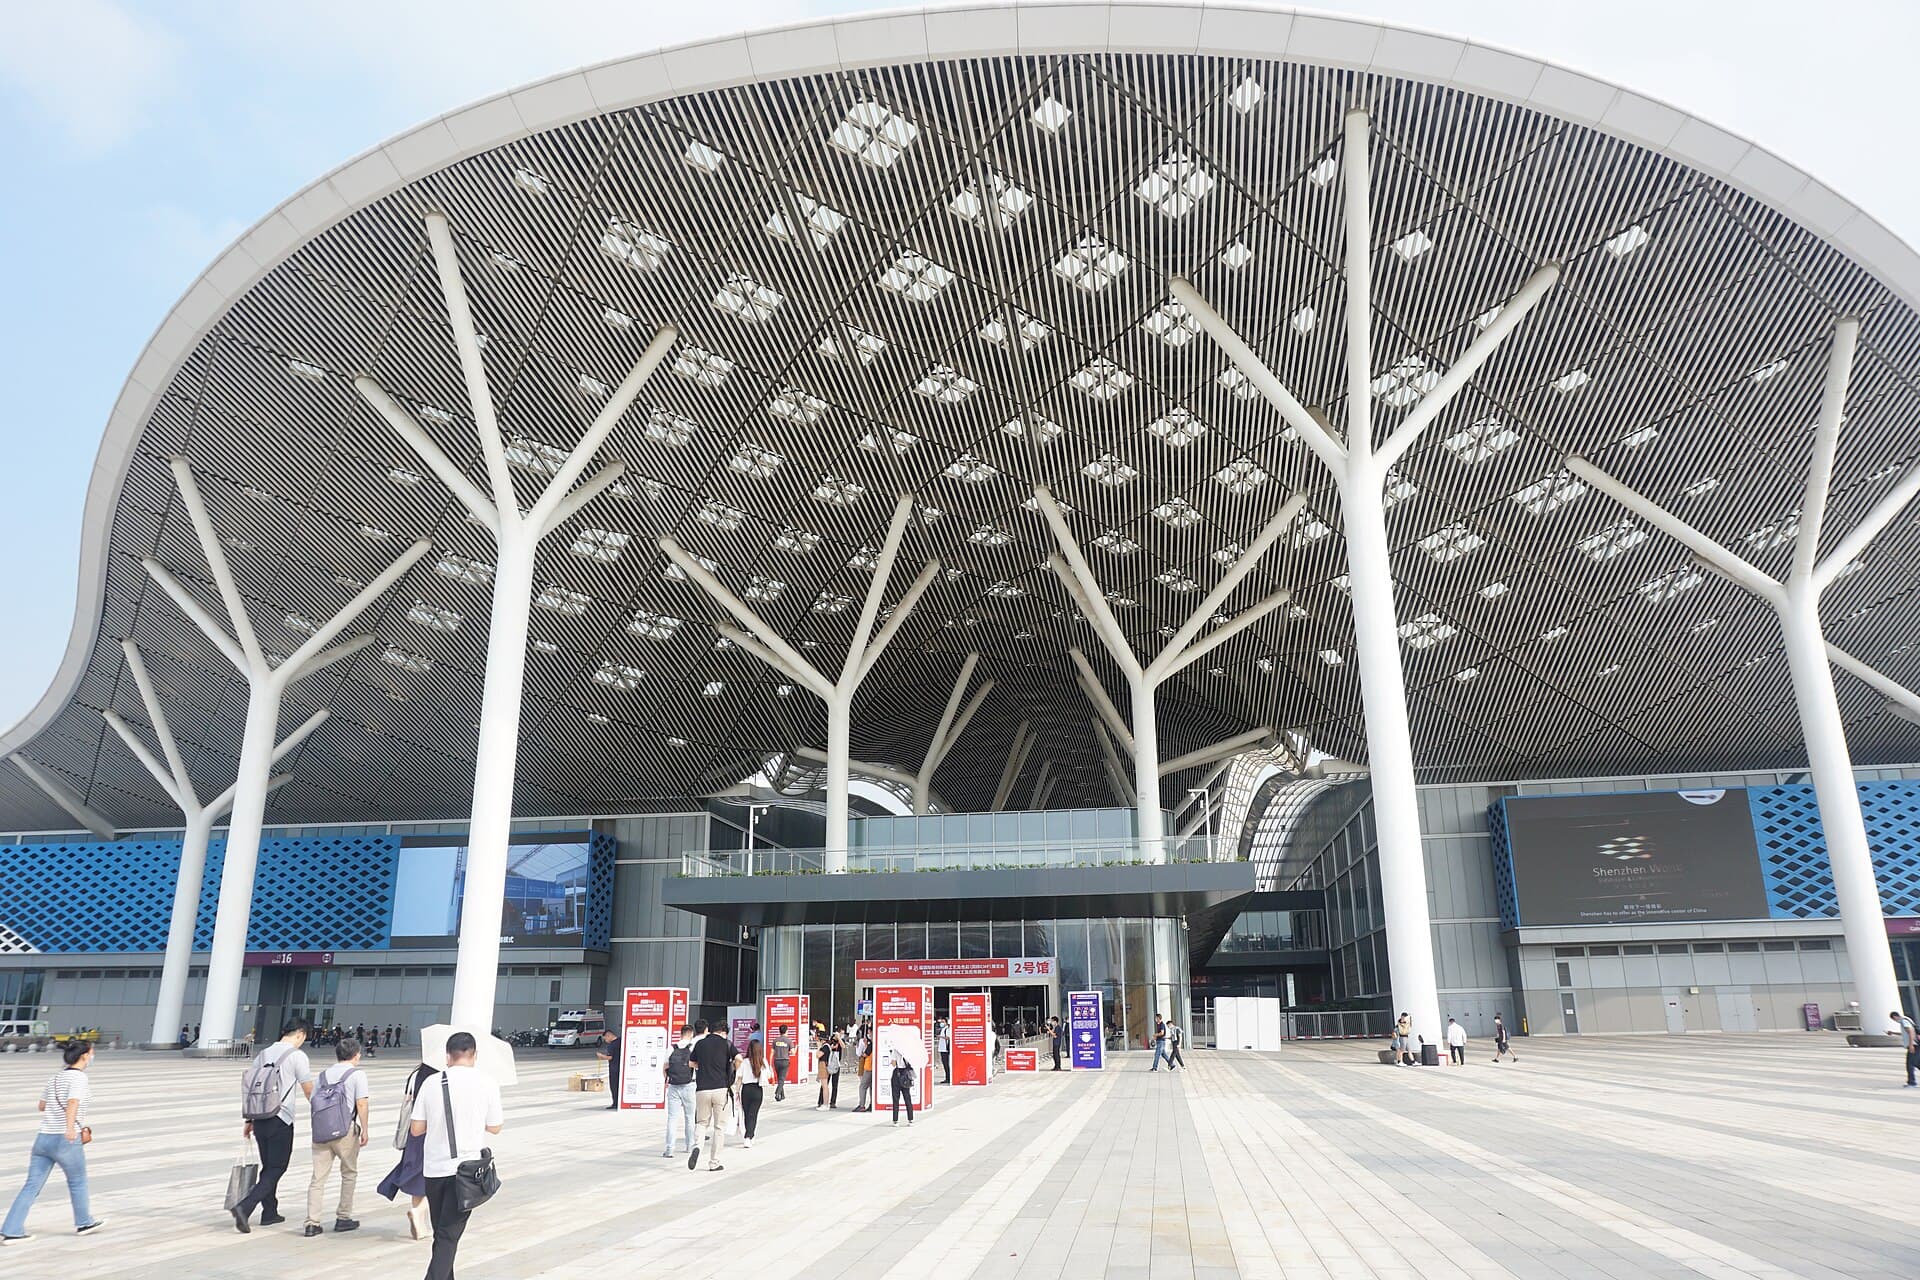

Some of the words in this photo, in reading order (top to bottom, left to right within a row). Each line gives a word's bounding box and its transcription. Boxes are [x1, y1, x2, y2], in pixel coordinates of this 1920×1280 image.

[1592, 865, 1647, 877] Shenzhen
[281, 953, 292, 964] 16
[1014, 961, 1049, 974] 2号馆
